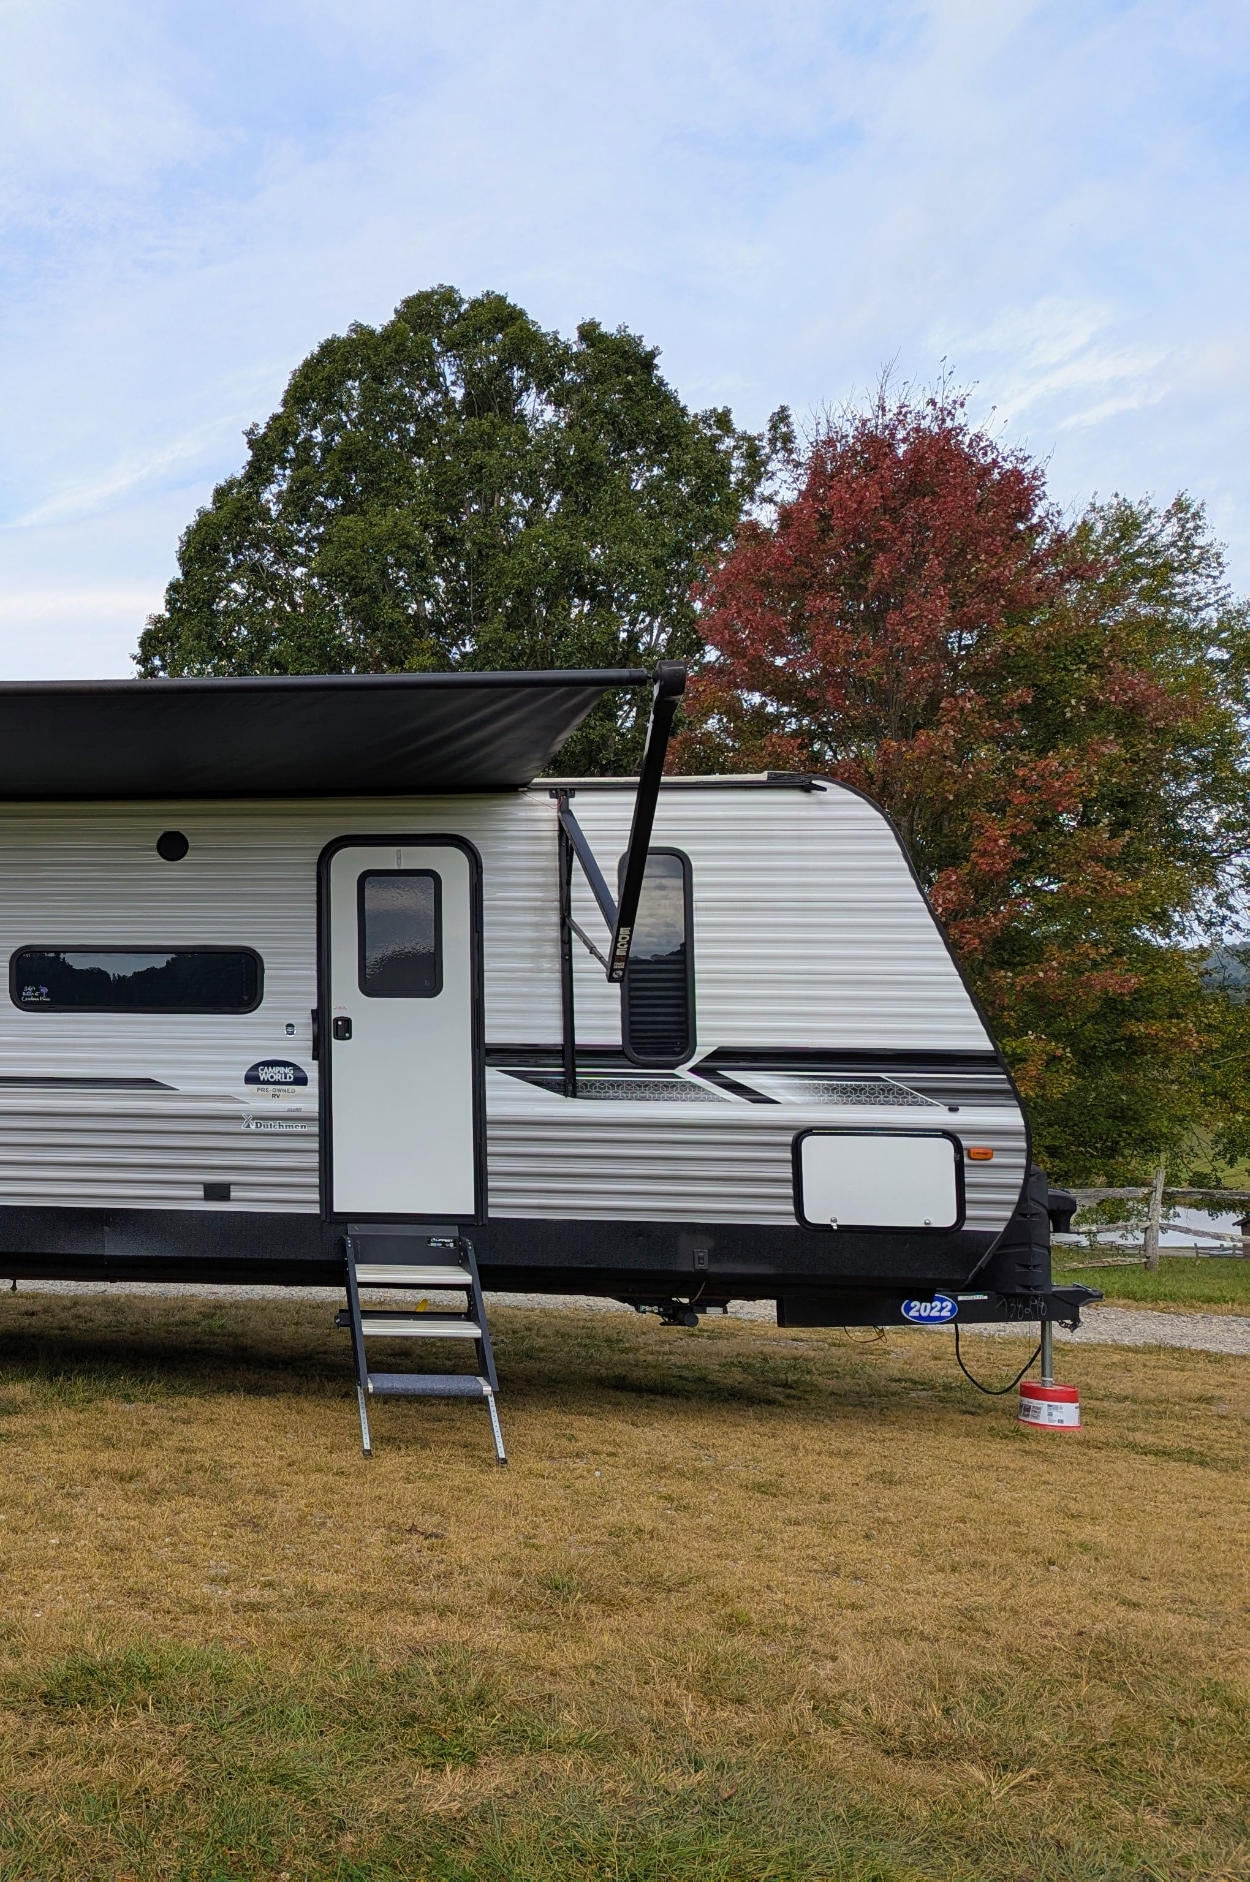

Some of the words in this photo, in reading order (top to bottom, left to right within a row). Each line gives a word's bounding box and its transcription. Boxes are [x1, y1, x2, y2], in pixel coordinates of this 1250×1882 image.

[615, 927, 631, 956] EDGE
[258, 1066, 294, 1074] CAMPING
[258, 1073, 294, 1082] WORLD
[255, 1121, 307, 1130] Dutchmen
[908, 1300, 952, 1317] 2022
